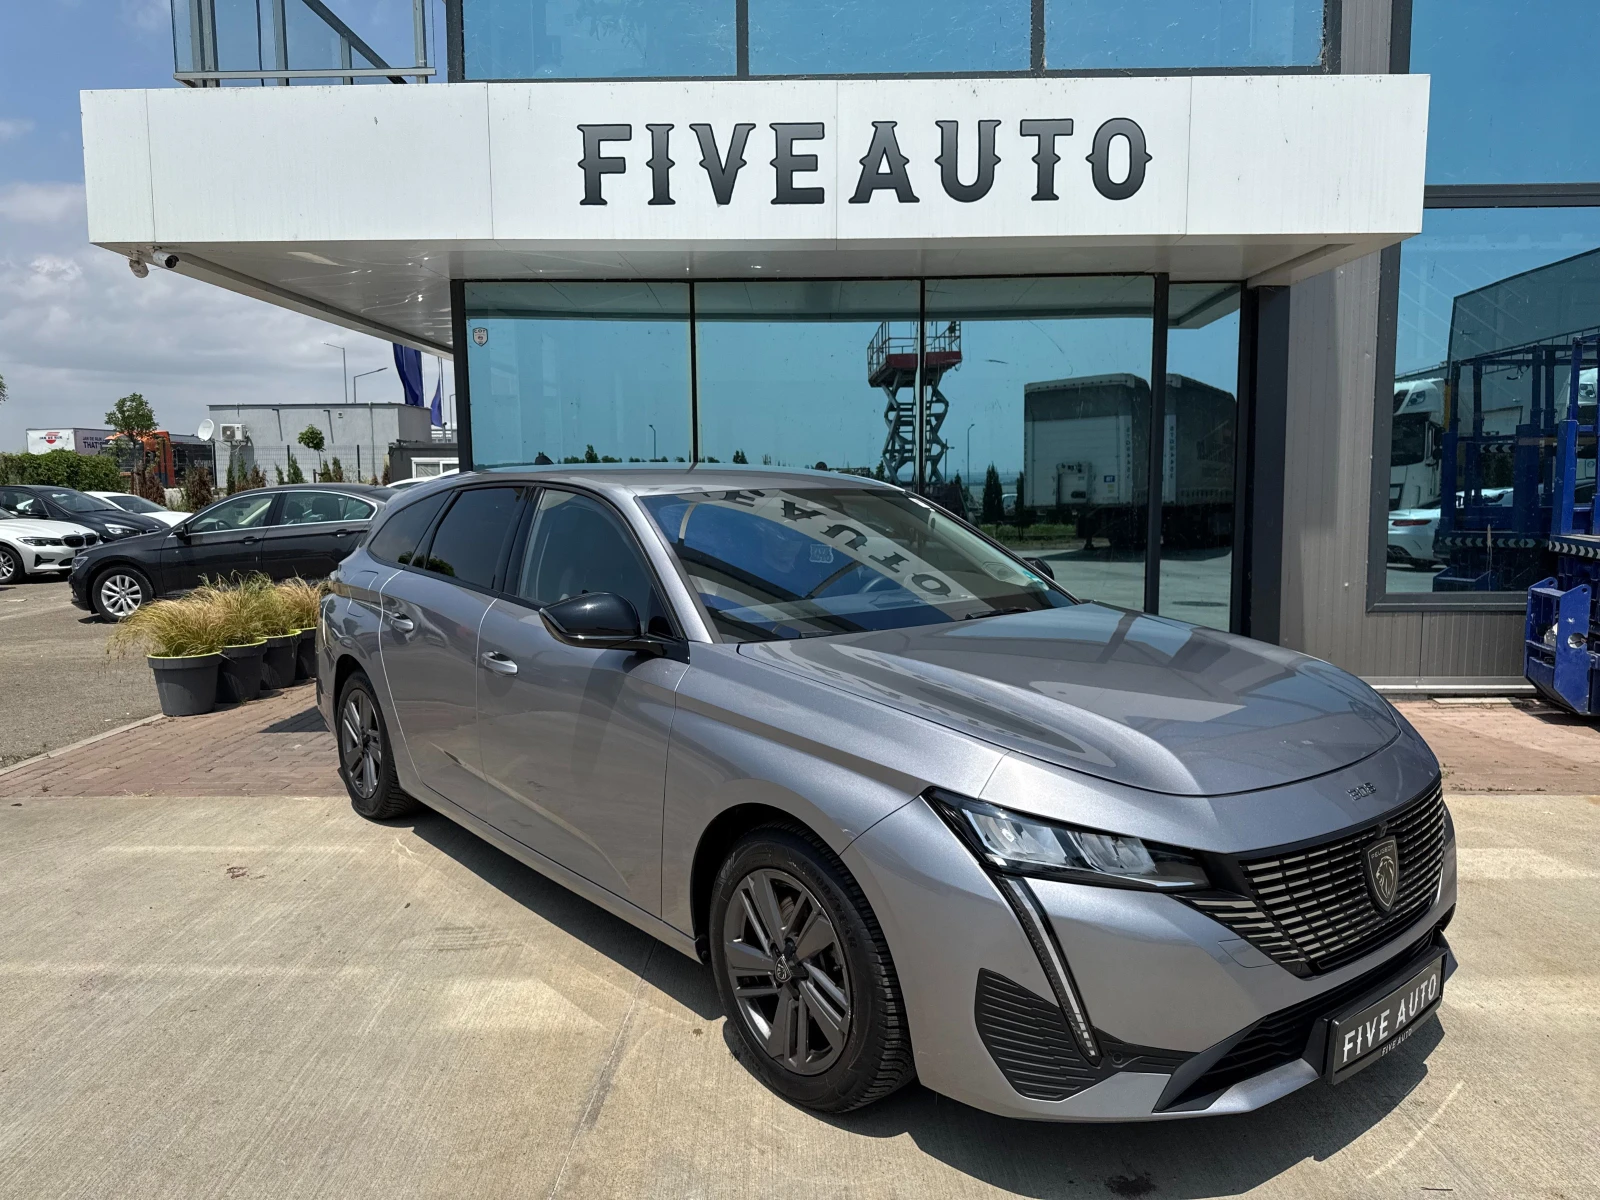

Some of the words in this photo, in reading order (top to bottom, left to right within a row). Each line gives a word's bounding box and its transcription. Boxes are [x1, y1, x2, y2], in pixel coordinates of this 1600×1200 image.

[577, 122, 826, 206] FIVE
[848, 117, 1154, 205] AUTO
[1371, 844, 1394, 859] PEUGEOT
[1342, 1008, 1390, 1064] FIVE
[1395, 973, 1437, 1030] AUTO
[1381, 1041, 1397, 1057] FIVE
[1397, 1028, 1413, 1046] AUTO
